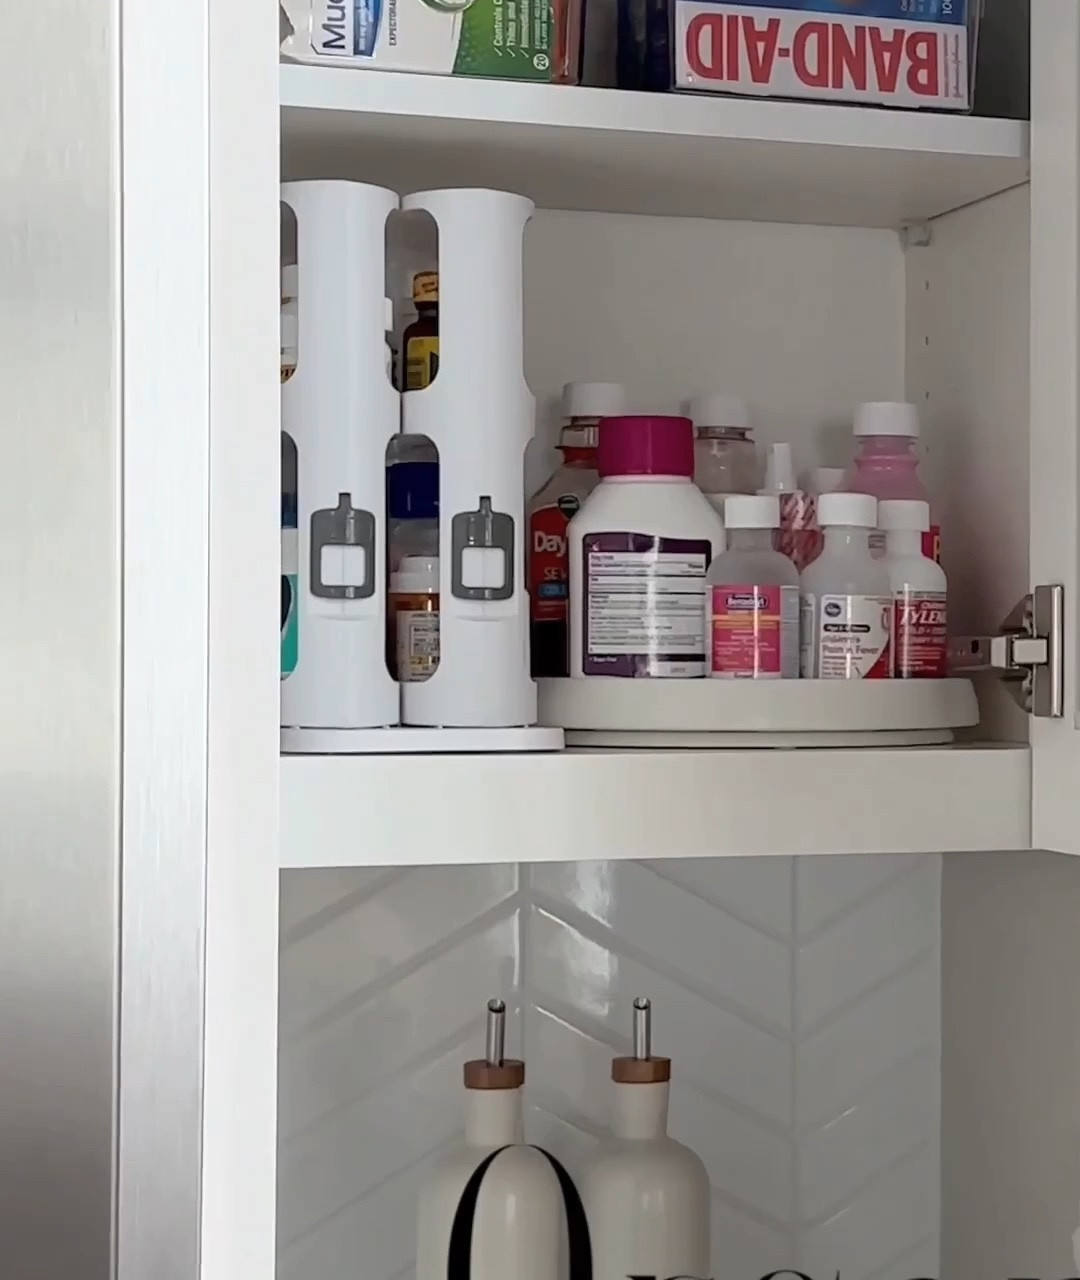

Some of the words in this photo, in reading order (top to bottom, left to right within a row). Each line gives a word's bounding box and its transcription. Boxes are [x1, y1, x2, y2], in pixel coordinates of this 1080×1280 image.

[493, 7, 503, 46] Controls
[536, 55, 547, 68] 20
[686, 12, 939, 96] BAND-AID
